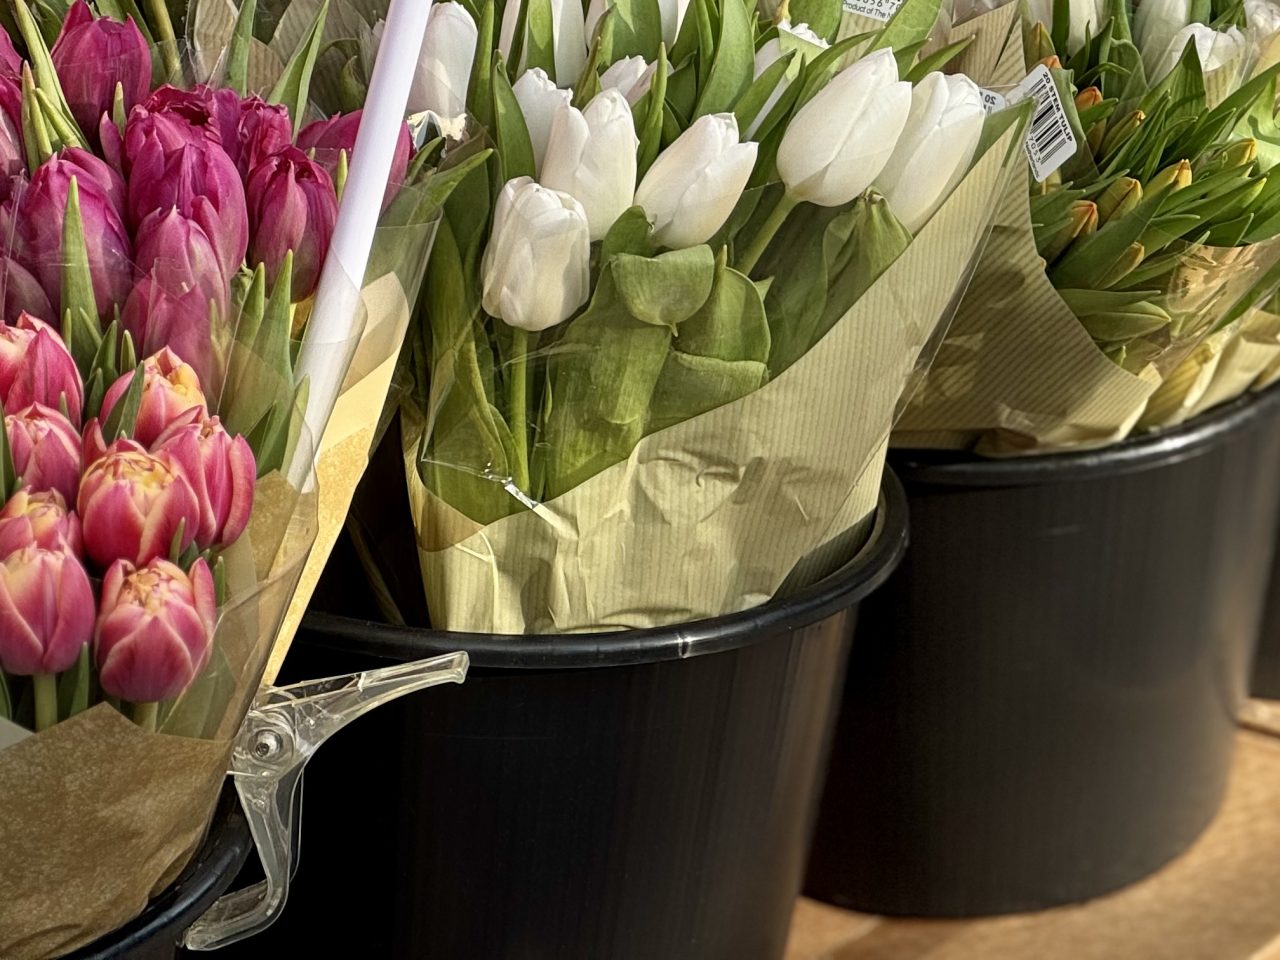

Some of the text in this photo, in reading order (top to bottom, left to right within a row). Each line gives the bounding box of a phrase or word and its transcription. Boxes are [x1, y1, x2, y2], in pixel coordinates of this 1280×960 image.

[866, 7, 874, 15] of
[1043, 71, 1073, 142] 20 STEM TULIP
